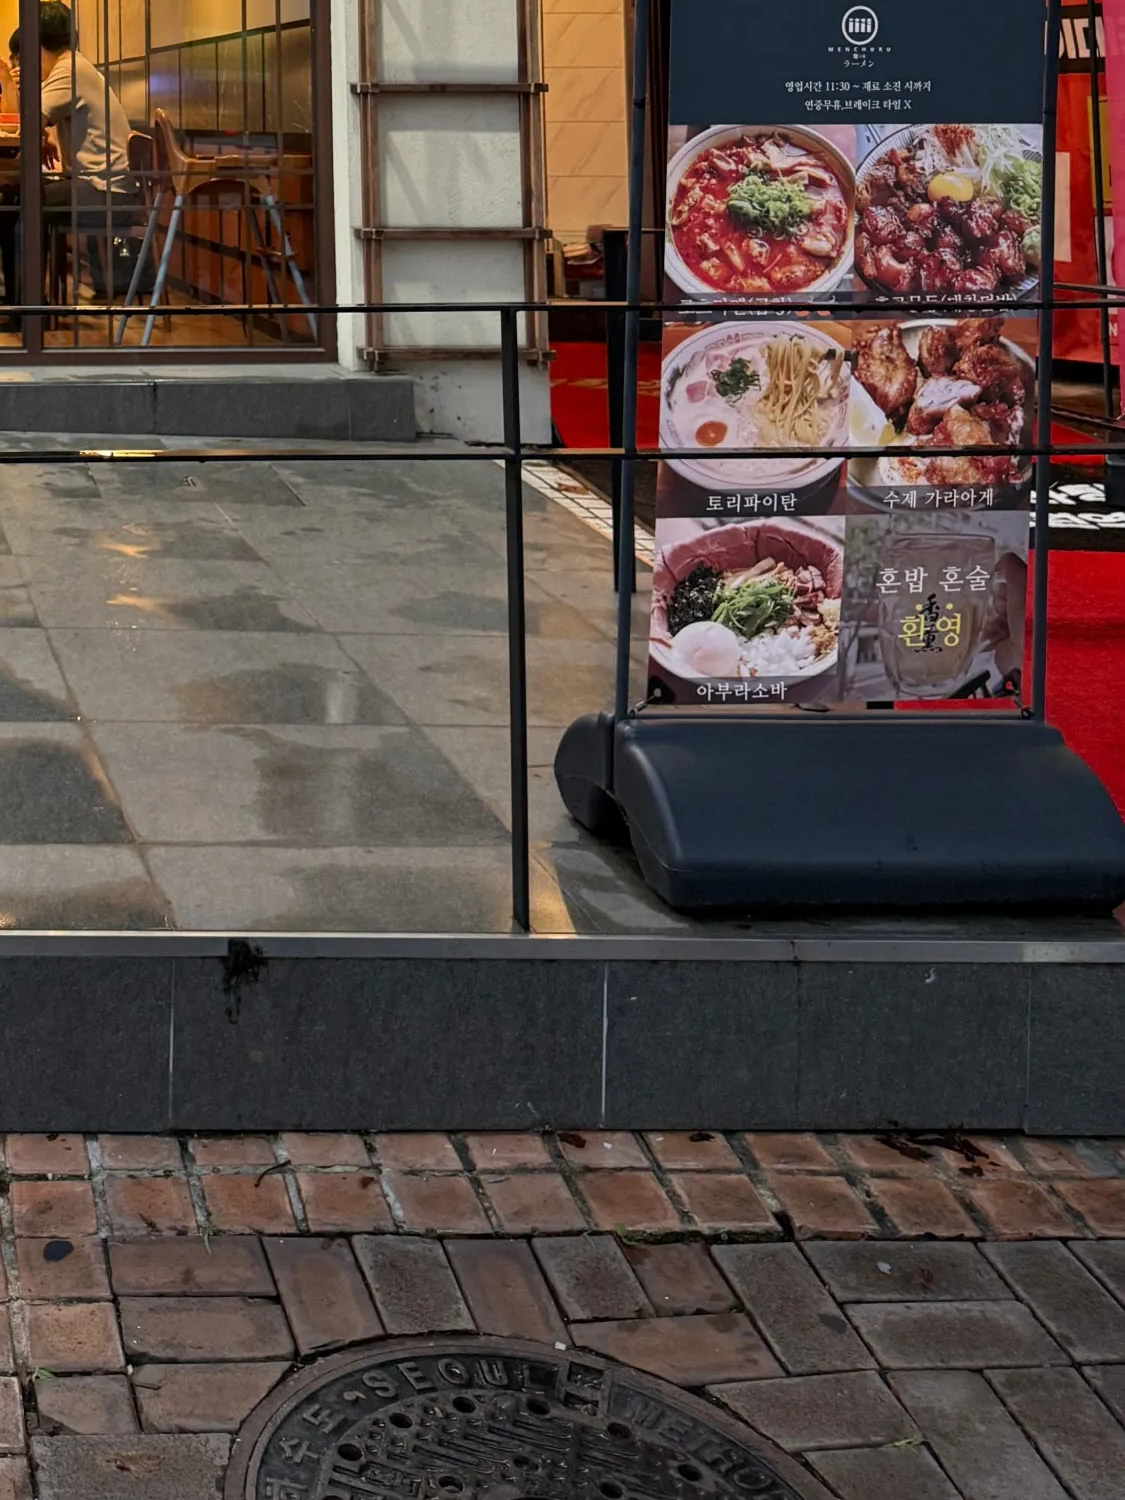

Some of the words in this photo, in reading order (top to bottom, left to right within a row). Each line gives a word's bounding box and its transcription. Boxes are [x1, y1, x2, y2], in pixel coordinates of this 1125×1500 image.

[785, 81, 822, 92] 영업시간
[825, 82, 850, 91] 11:30
[862, 81, 880, 92] 재료
[904, 81, 931, 92] 시까지
[883, 99, 901, 110] 타임
[903, 100, 912, 110] X
[706, 492, 797, 513] 토리파이탄
[883, 491, 918, 510] 수제
[924, 488, 994, 508] 가라아게
[876, 566, 928, 594] 혼밥
[939, 565, 991, 592] 혼술
[897, 612, 961, 647] 환영
[696, 682, 788, 703] 아부라소바
